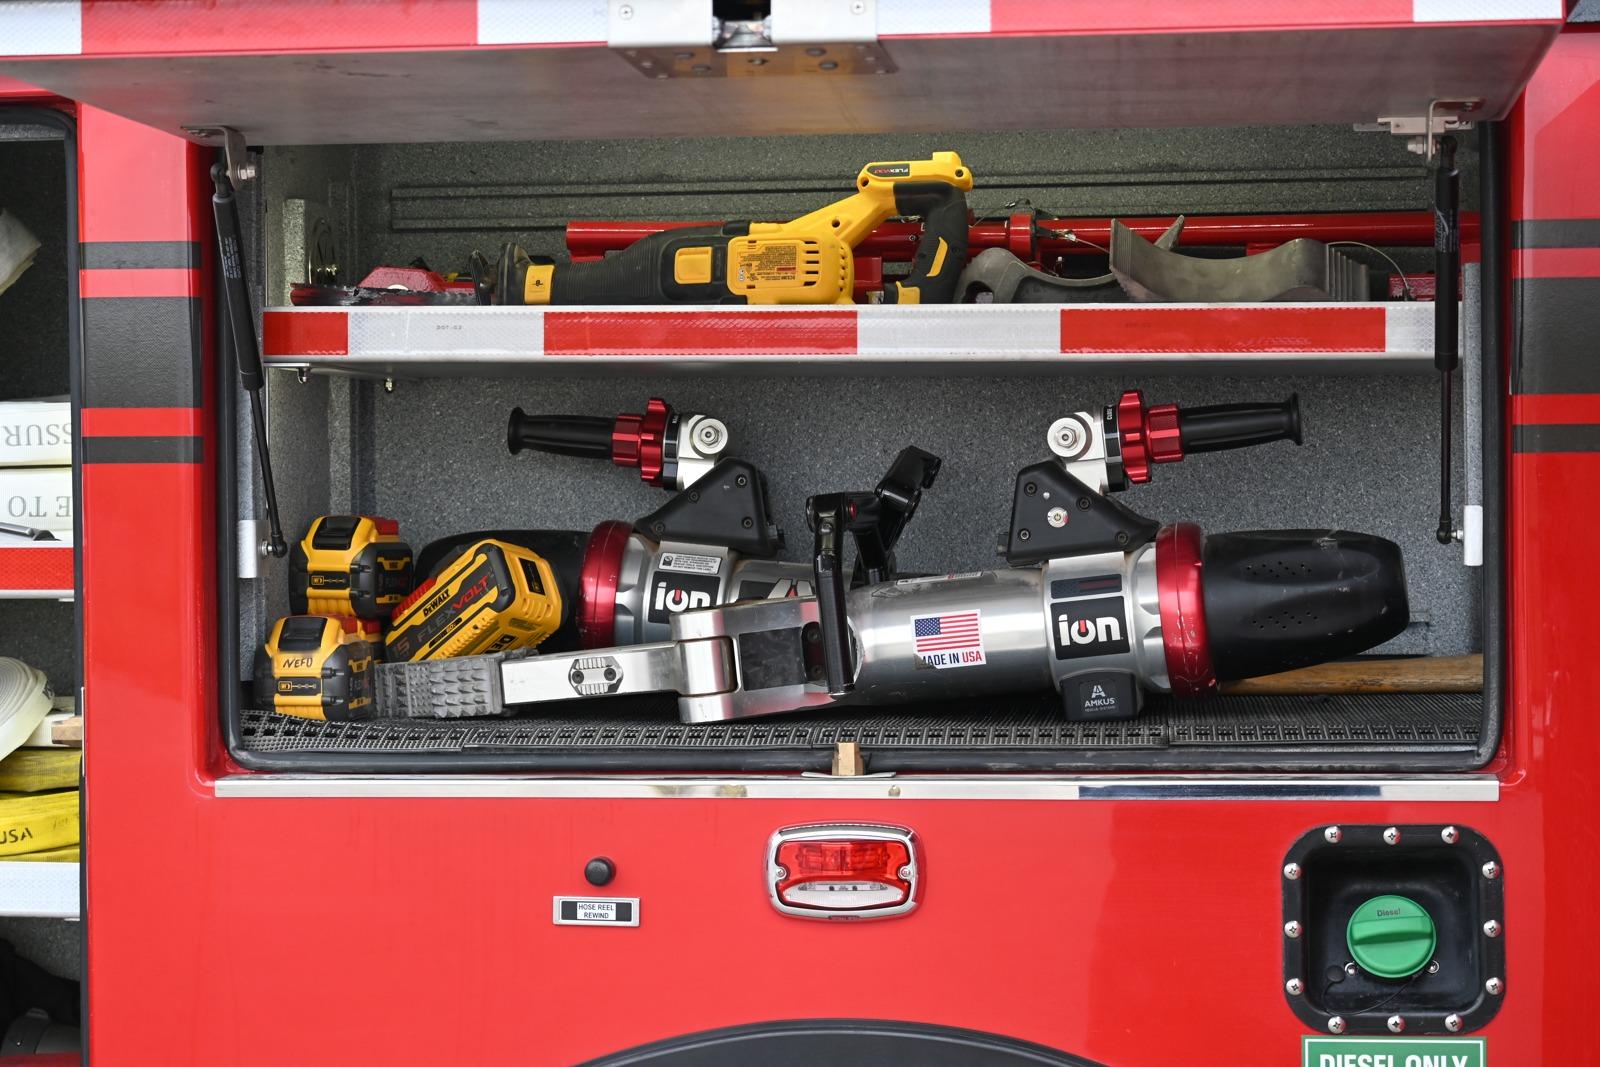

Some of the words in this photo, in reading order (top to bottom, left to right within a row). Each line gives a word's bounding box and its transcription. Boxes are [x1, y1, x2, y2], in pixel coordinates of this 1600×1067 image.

[8, 496, 47, 517] TO
[1058, 614, 1122, 646] ion
[949, 653, 960, 664] IN
[962, 651, 982, 663] USA
[1084, 697, 1116, 707] AMKUS
[1376, 907, 1401, 917] Diesel
